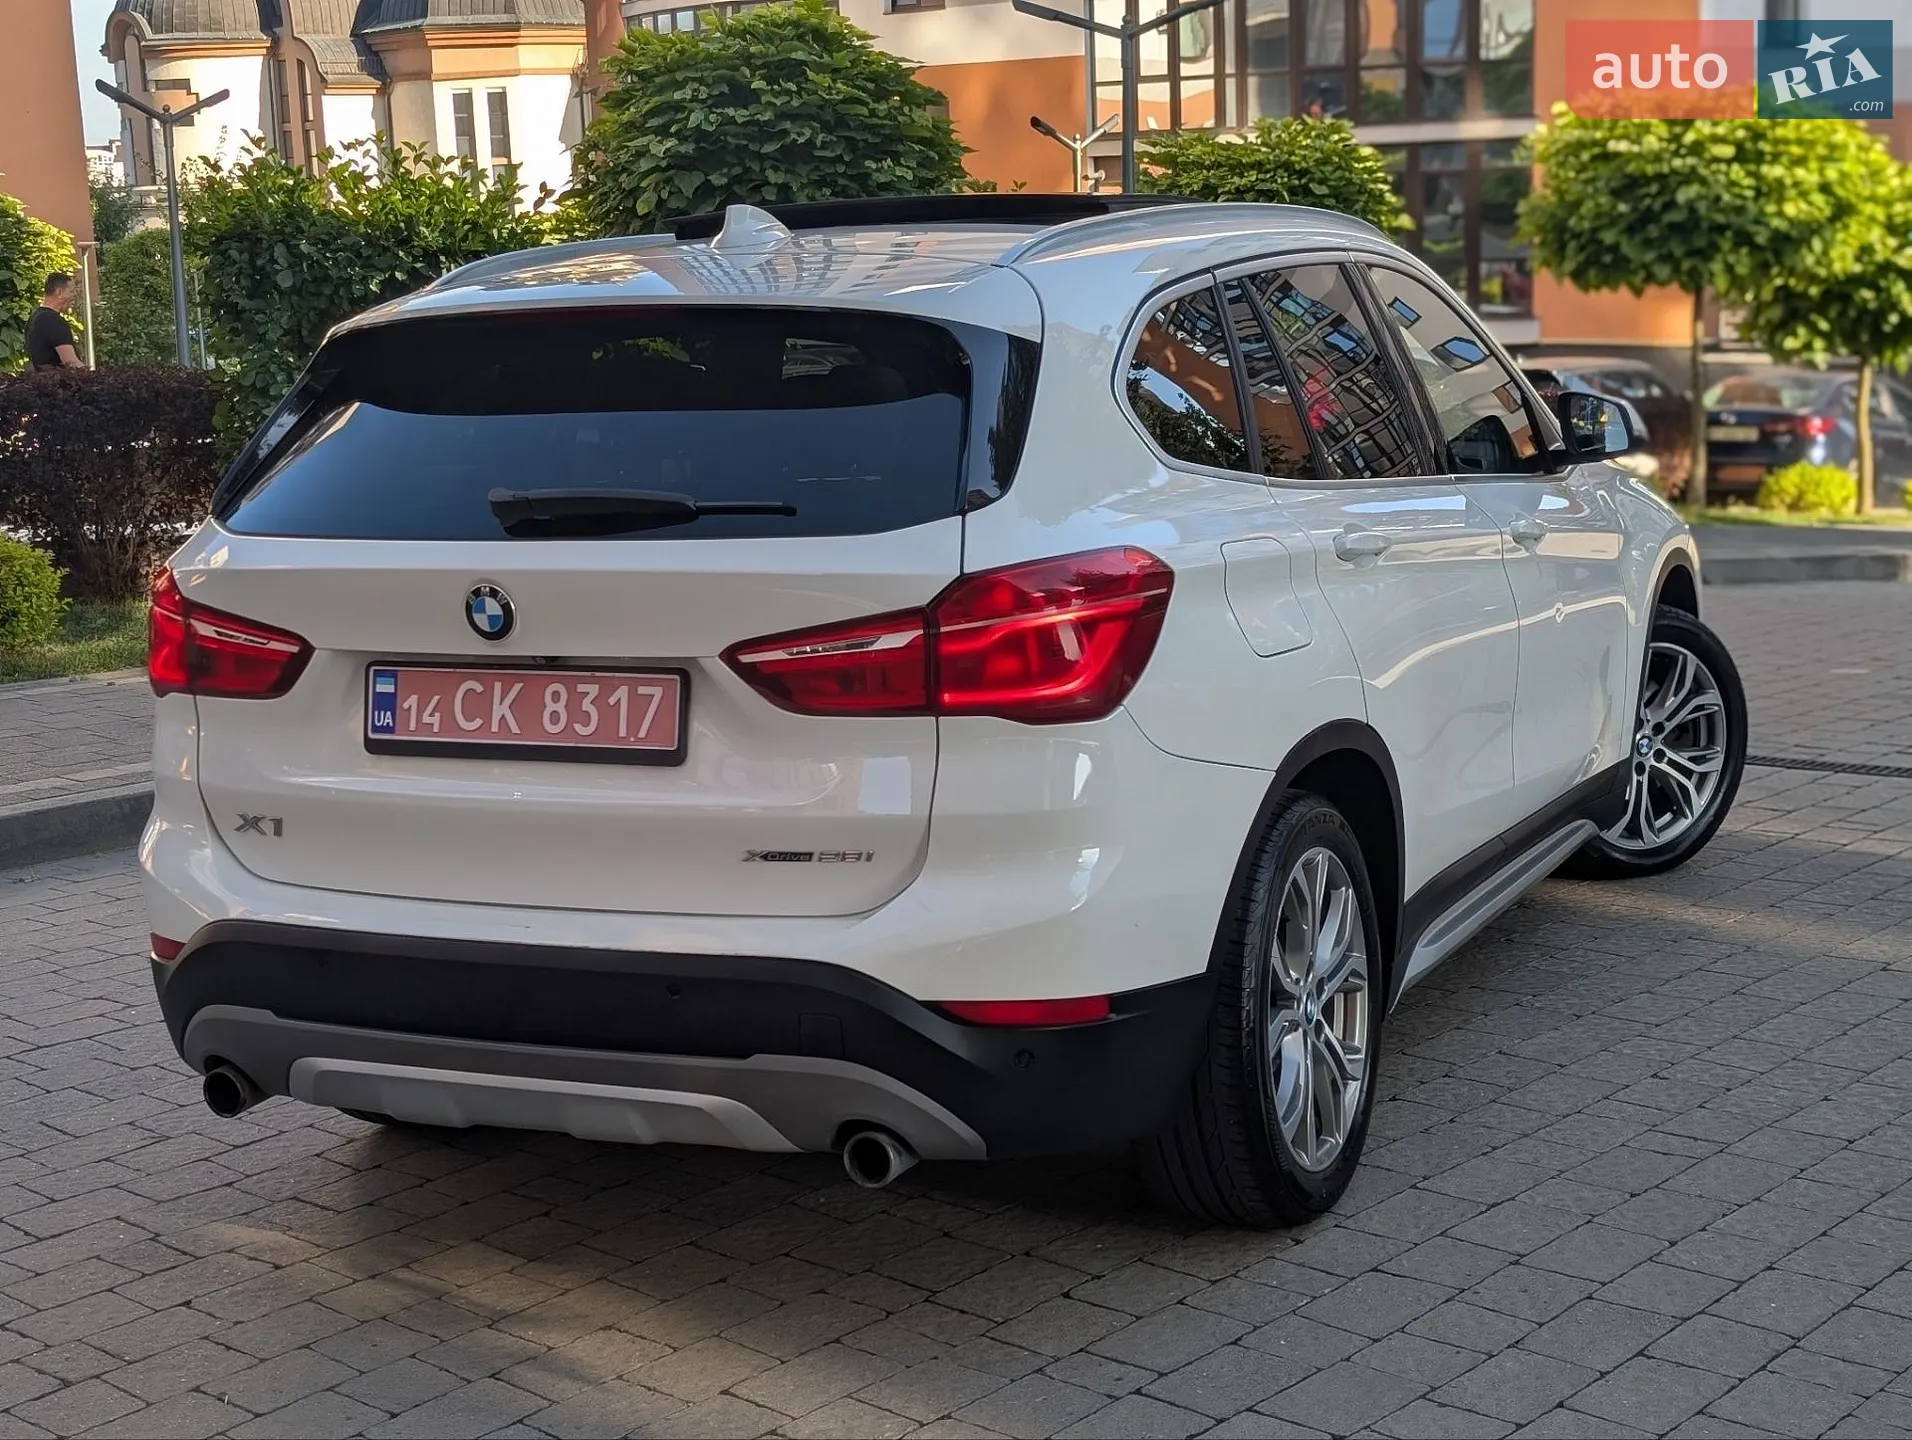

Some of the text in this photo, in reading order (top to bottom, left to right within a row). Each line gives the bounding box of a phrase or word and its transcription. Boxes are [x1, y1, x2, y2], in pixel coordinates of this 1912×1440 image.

[468, 586, 508, 605] BMW
[374, 710, 394, 727] UA
[402, 694, 441, 733] 14
[542, 682, 664, 738] 8317
[233, 812, 283, 837] X1
